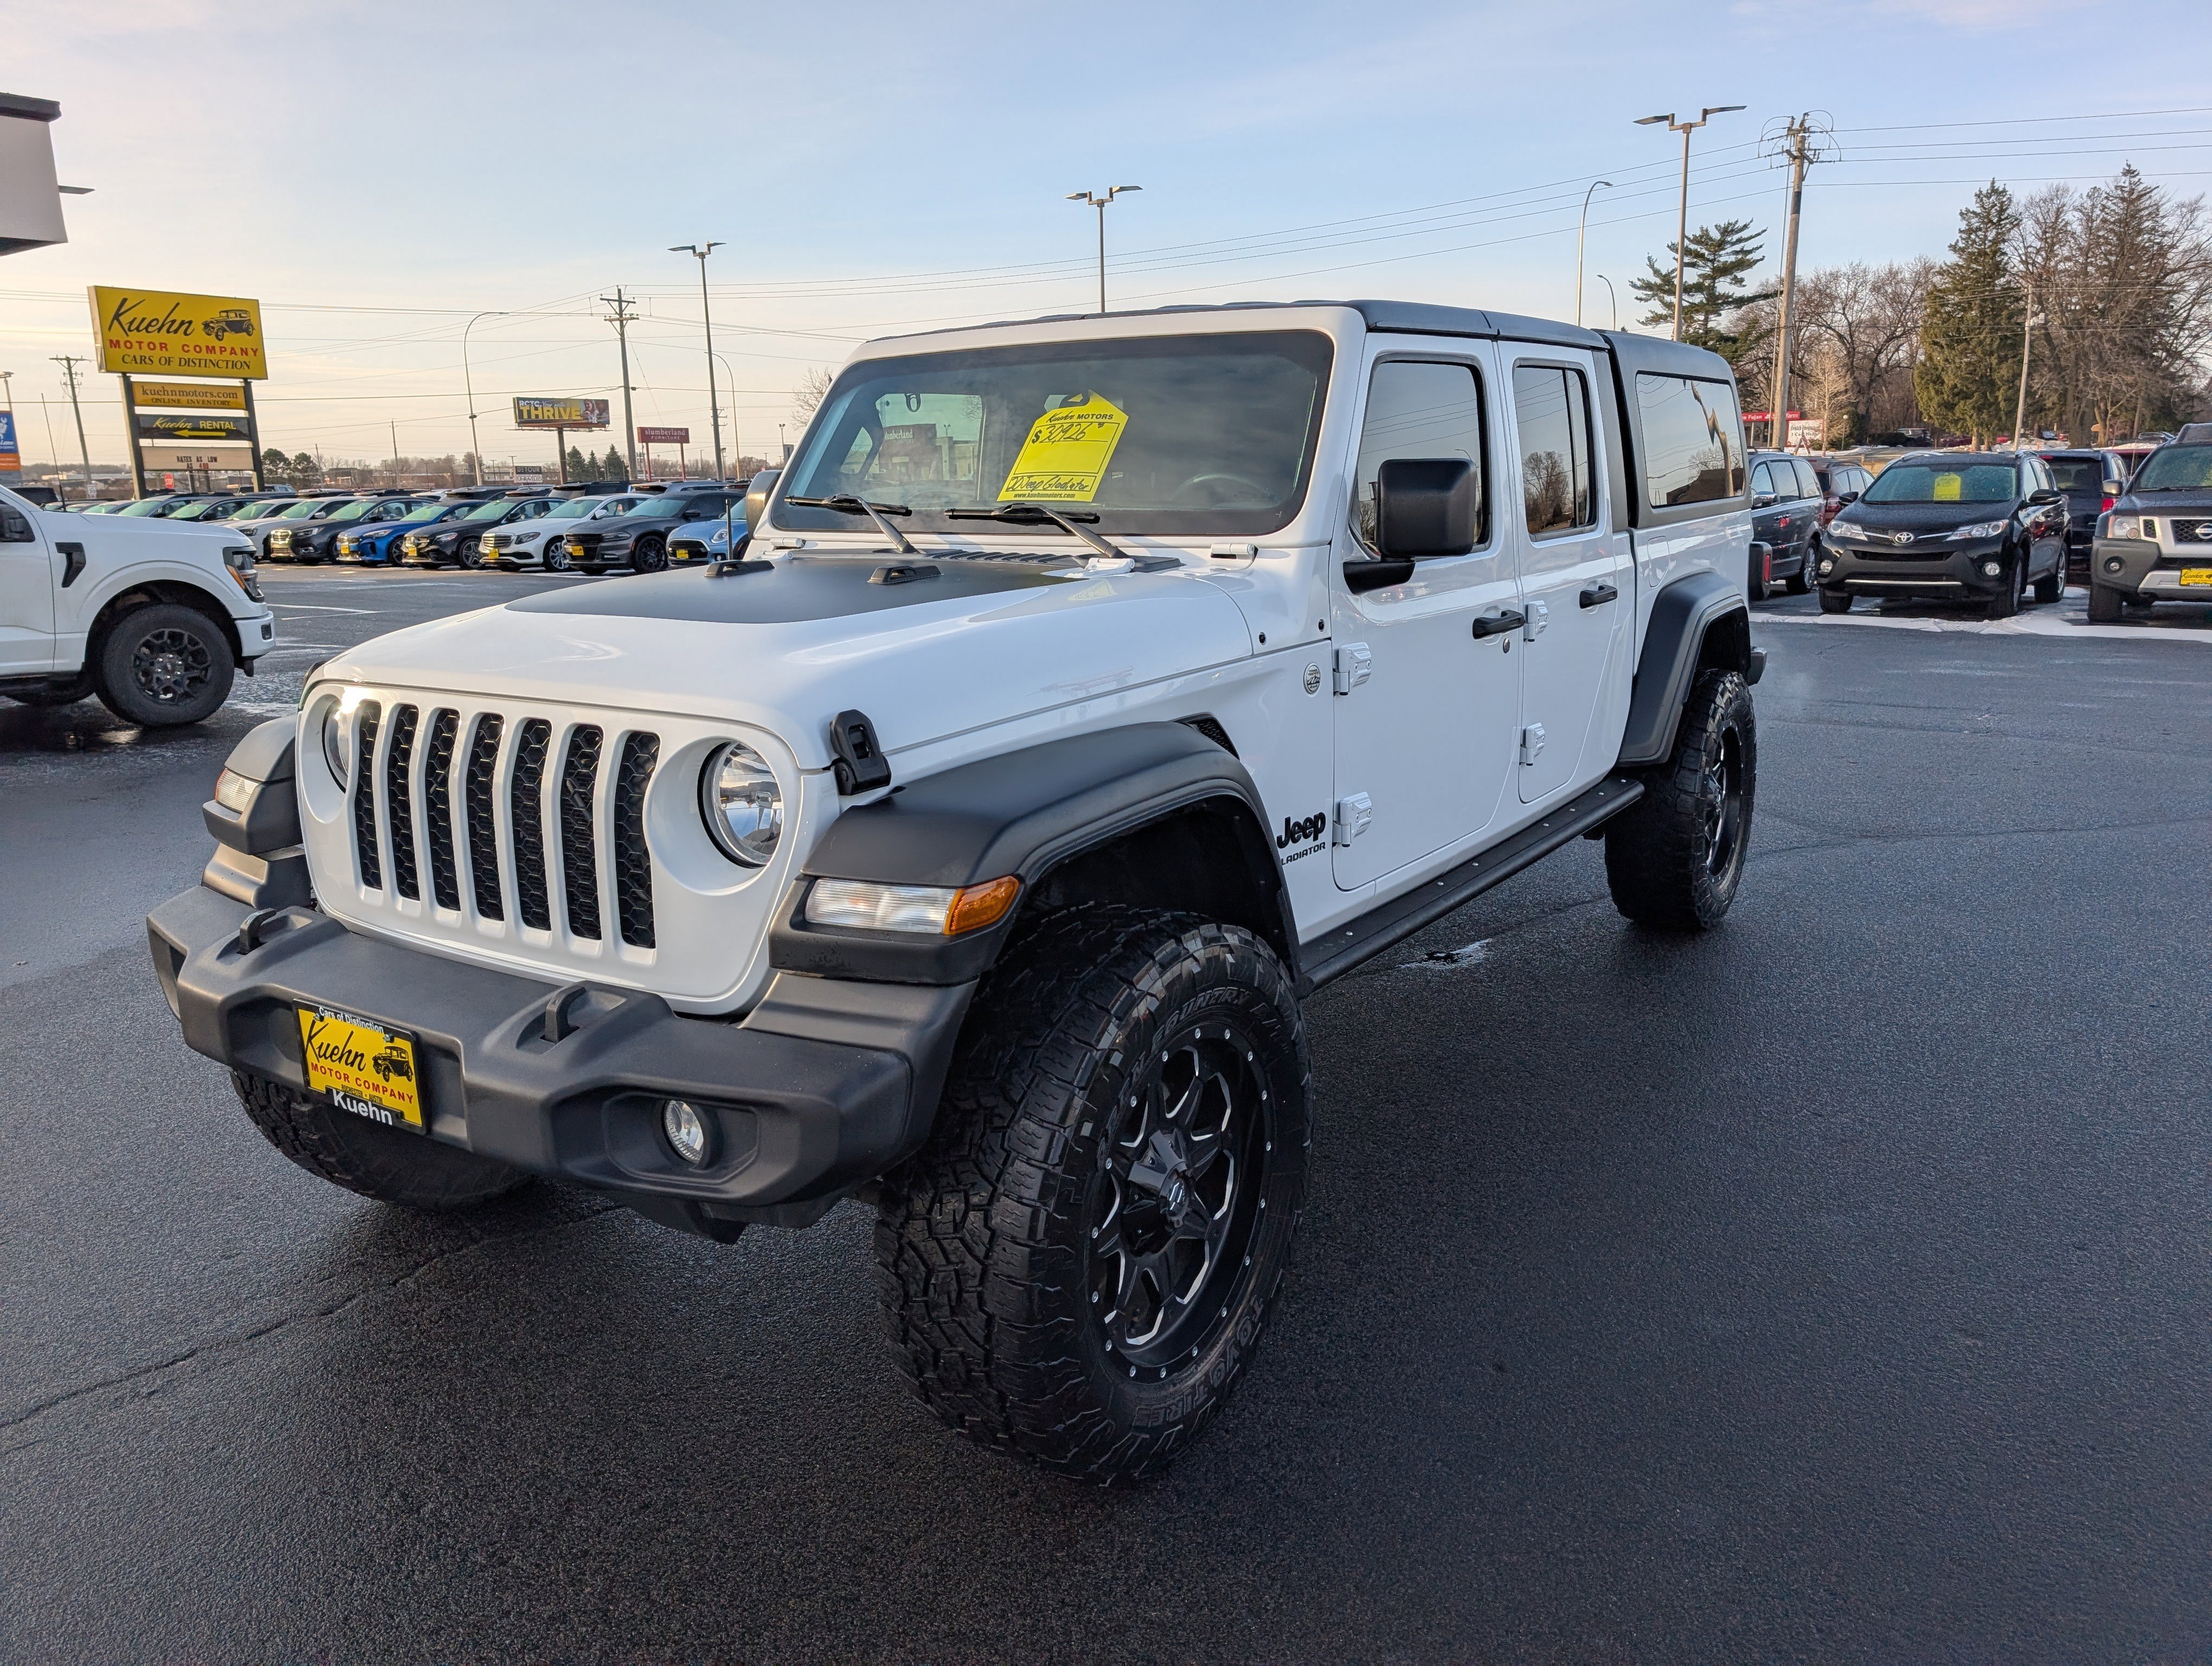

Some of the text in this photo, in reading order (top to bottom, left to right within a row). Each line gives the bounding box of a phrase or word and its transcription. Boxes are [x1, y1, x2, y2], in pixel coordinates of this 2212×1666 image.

[108, 298, 195, 337] Kuehn
[109, 339, 259, 357] MOTOR COMPANY
[122, 354, 251, 370] CARS OF DISTINCTION
[142, 386, 238, 399] kuehnmotors.com
[153, 417, 237, 430] Kuehn RENTAL
[1046, 410, 1075, 423] Kuehn
[1277, 812, 1326, 849] Jeep
[1281, 842, 1326, 866] LADIATOR
[319, 1007, 384, 1034] Cars of Distinction
[305, 1018, 366, 1072] Kuehn
[310, 1061, 414, 1104] MOTOR COMPANY
[332, 1089, 393, 1126] Kuehn
